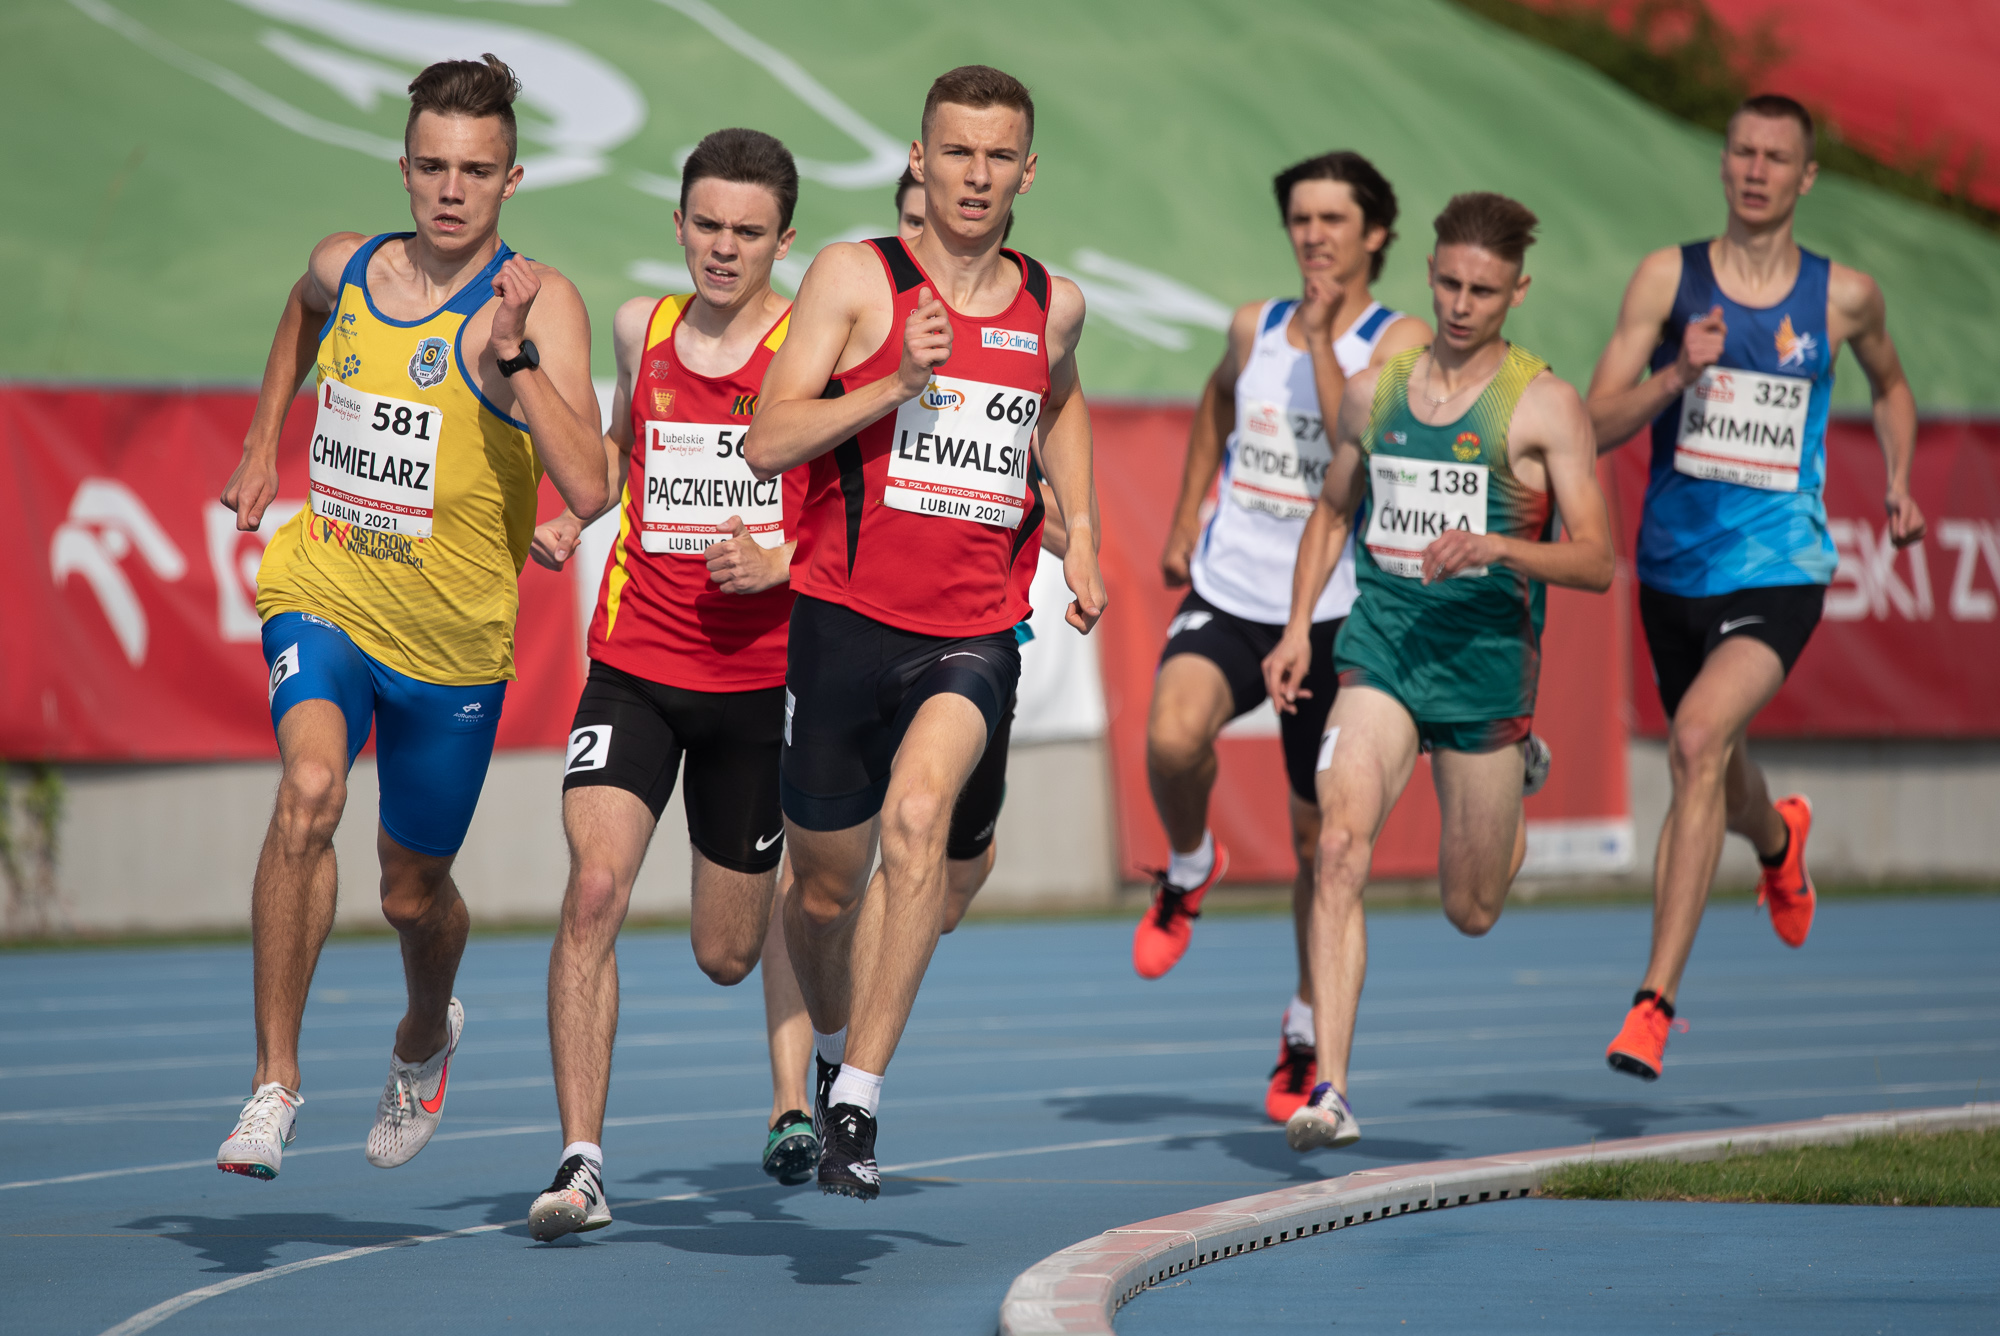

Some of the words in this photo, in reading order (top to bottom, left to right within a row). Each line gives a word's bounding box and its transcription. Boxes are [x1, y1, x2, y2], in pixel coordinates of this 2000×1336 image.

[1009, 334, 1038, 351] clinica
[929, 392, 957, 406] LOTTO
[985, 392, 1036, 428] 669
[1755, 381, 1803, 410] 325
[371, 401, 431, 441] 581
[1686, 408, 1797, 450] SKIMINA
[312, 433, 431, 491] CHMIELARZ
[899, 429, 1026, 480] LEWALSKI
[647, 476, 779, 511] PĄCZKIEWICZ
[894, 479, 906, 488] 75.
[908, 481, 931, 492] PZLA
[932, 485, 992, 501] MISTRZOSTWA
[992, 494, 1012, 505] POLSKI
[1430, 468, 1479, 496] 138
[315, 484, 331, 496] PZLA
[331, 489, 380, 509] MISTRZOSTWA
[379, 503, 408, 514] POLSKI
[409, 507, 428, 516] U20
[321, 500, 361, 524] LUBLIN
[363, 512, 398, 531] 2021
[920, 497, 971, 517] LUBLIN
[974, 505, 1006, 524] 2021
[657, 523, 676, 531] PZLA
[677, 524, 717, 533] MISTRZOS
[764, 523, 780, 532] U20
[1379, 501, 1471, 537] ĆWIKŁA
[346, 540, 424, 570] WIELKOPOLSKI
[669, 538, 715, 551] LUBLIN
[271, 655, 288, 692] 6
[568, 730, 599, 771] 2
